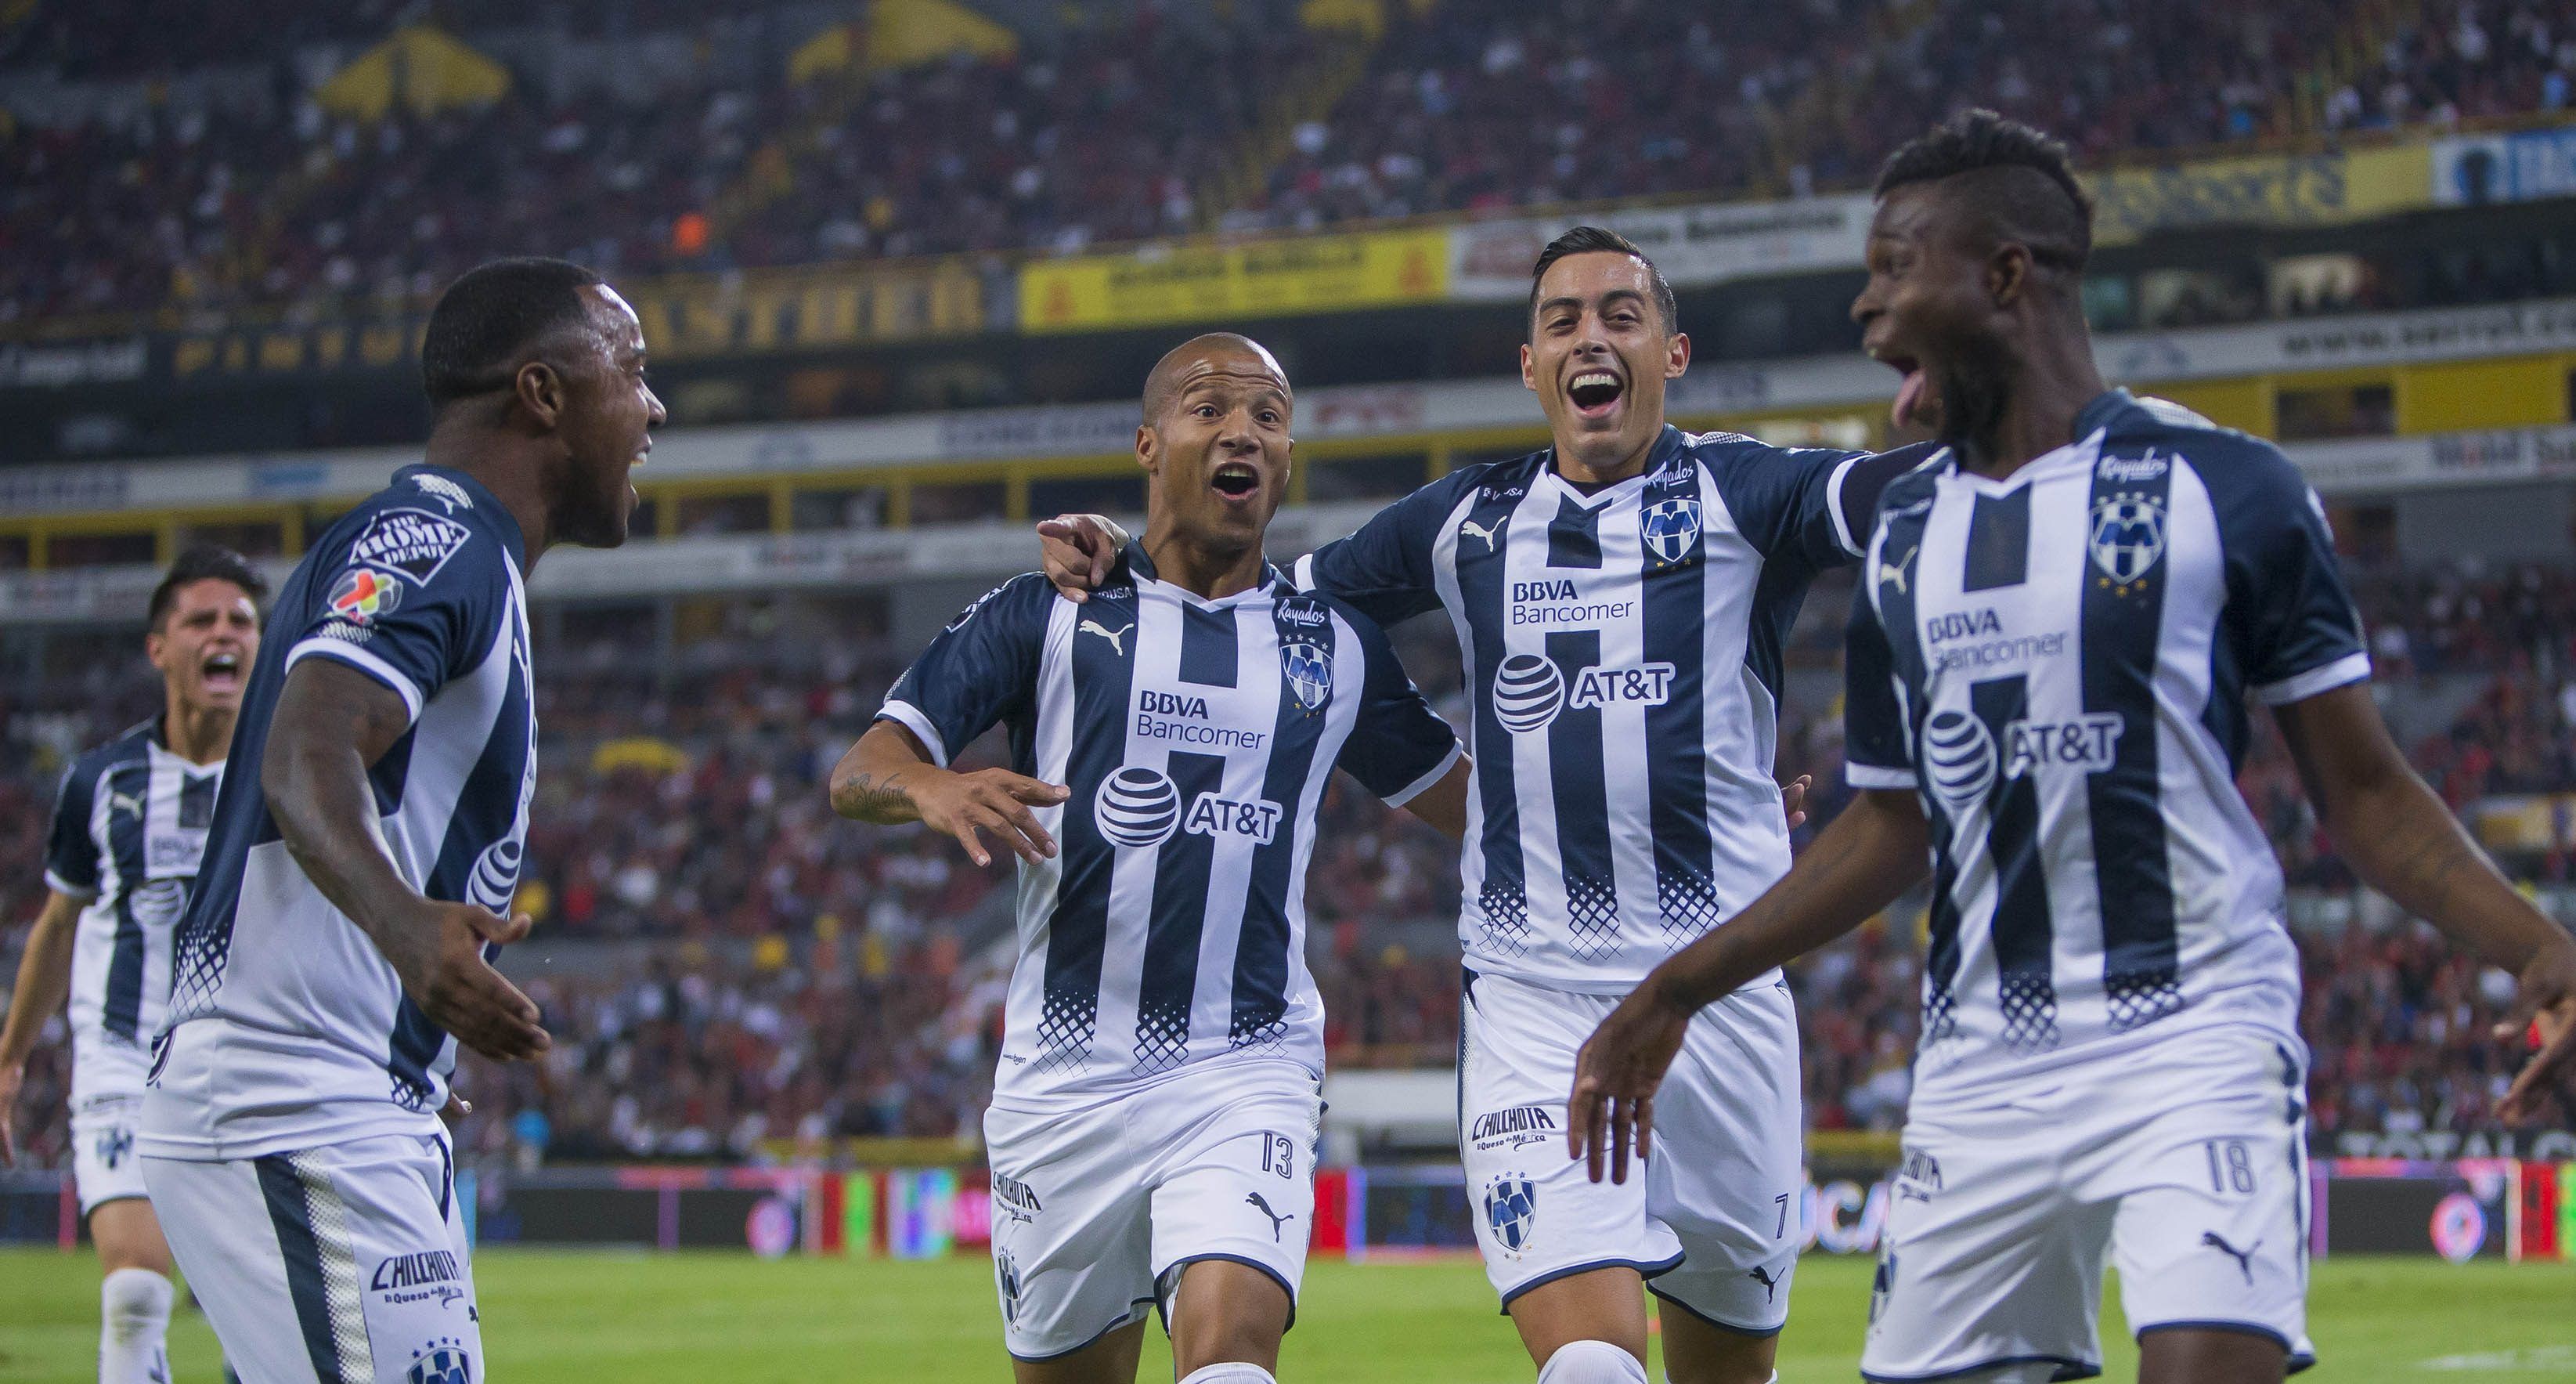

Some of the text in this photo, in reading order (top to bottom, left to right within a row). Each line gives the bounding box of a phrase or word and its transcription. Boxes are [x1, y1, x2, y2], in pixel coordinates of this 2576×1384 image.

[1513, 580, 1578, 602] BBVA
[1277, 598, 1326, 627] Rayados
[1513, 602, 1634, 625] Bancomer
[1576, 668, 1670, 704] AT&T
[1139, 690, 1209, 719] BBVA
[1137, 714, 1266, 750] Bancomer
[2006, 722, 2119, 765] AT&T
[1189, 797, 1278, 840] AT&T
[1472, 1107, 1556, 1141] CHILCHOTA
[1262, 1132, 1293, 1179] 13
[2206, 1140, 2255, 1193] 18
[1775, 1193, 1788, 1239] 7
